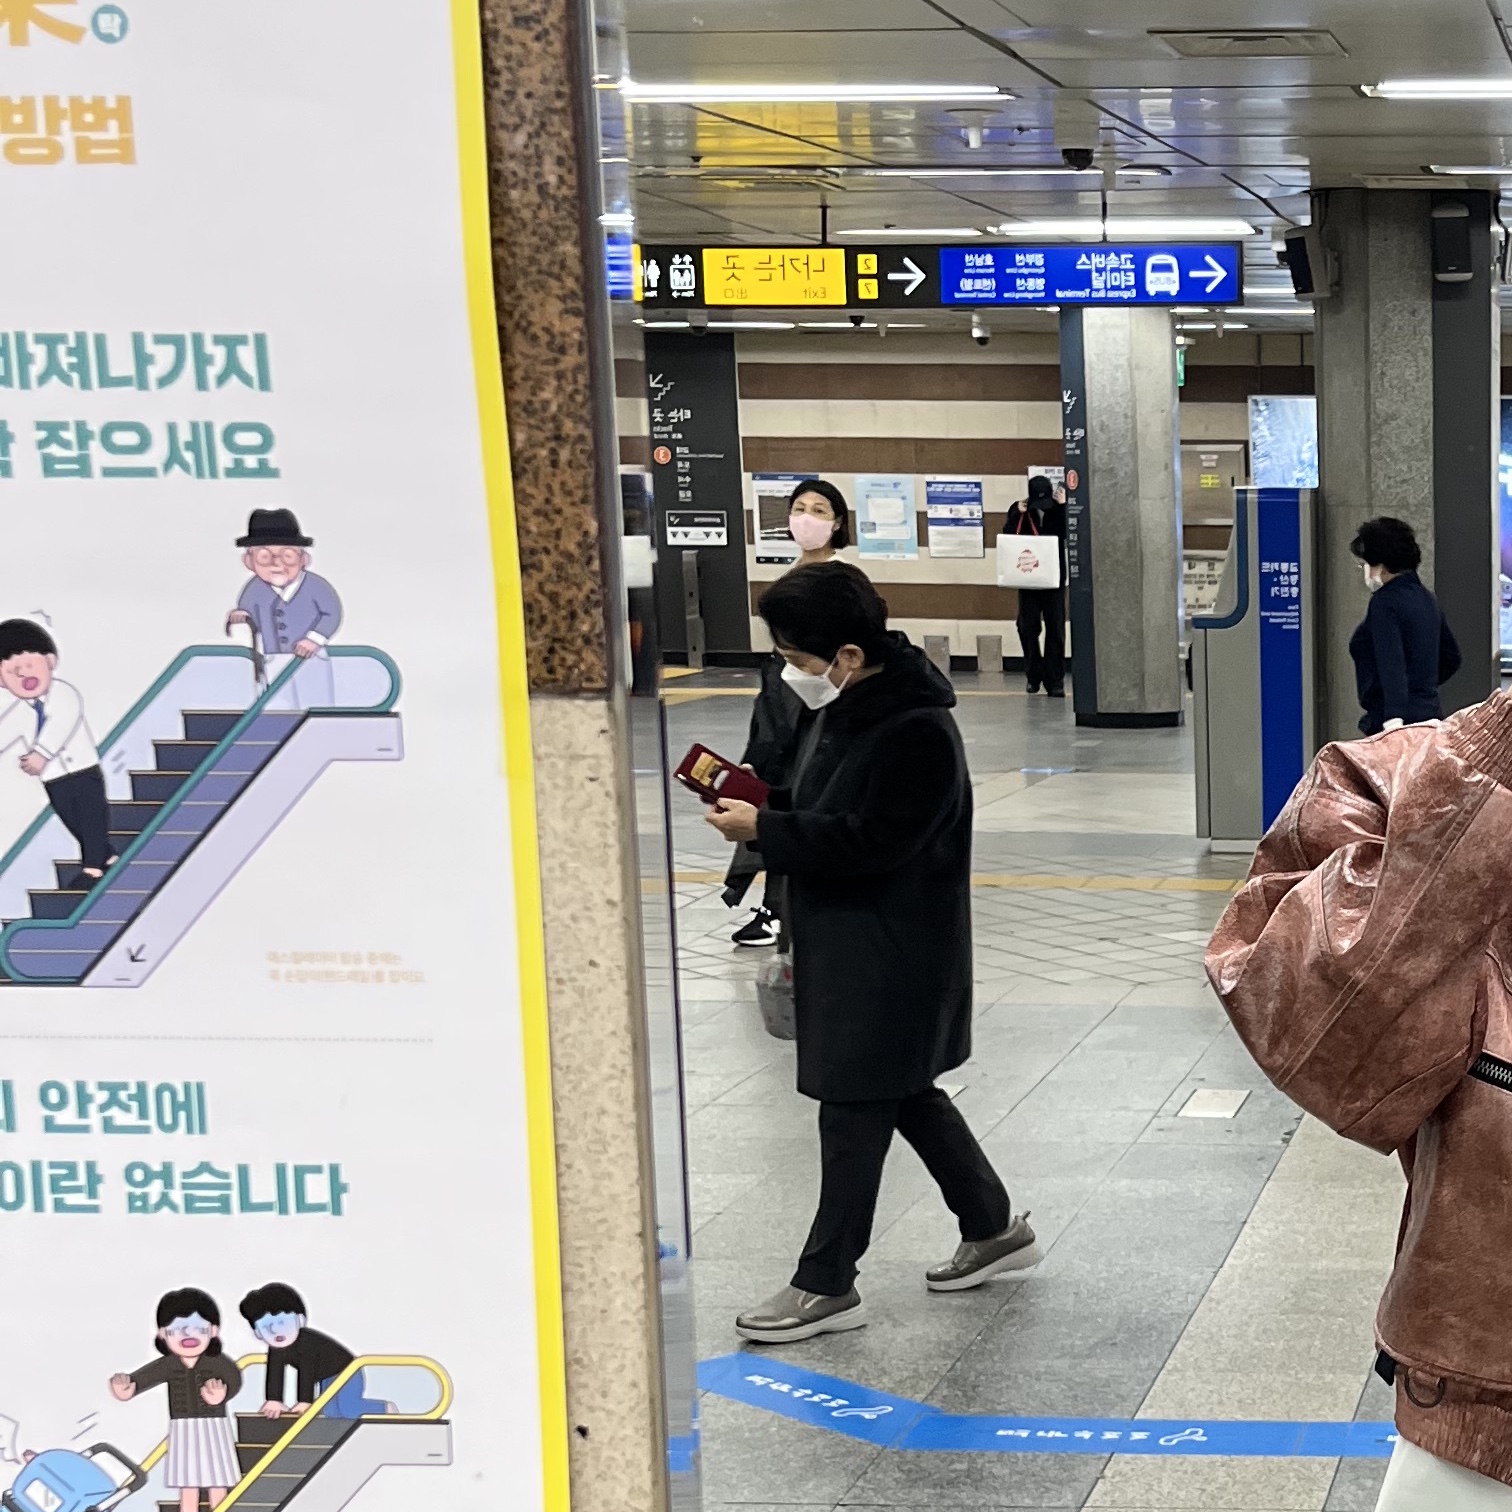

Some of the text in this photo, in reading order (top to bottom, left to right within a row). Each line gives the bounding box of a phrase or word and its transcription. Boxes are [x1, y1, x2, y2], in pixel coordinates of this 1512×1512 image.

[0, 95, 137, 165] 방법
[36, 420, 281, 479] 잡으세요
[39, 1080, 208, 1135] 안전에
[123, 1162, 350, 1217] 없습니다
